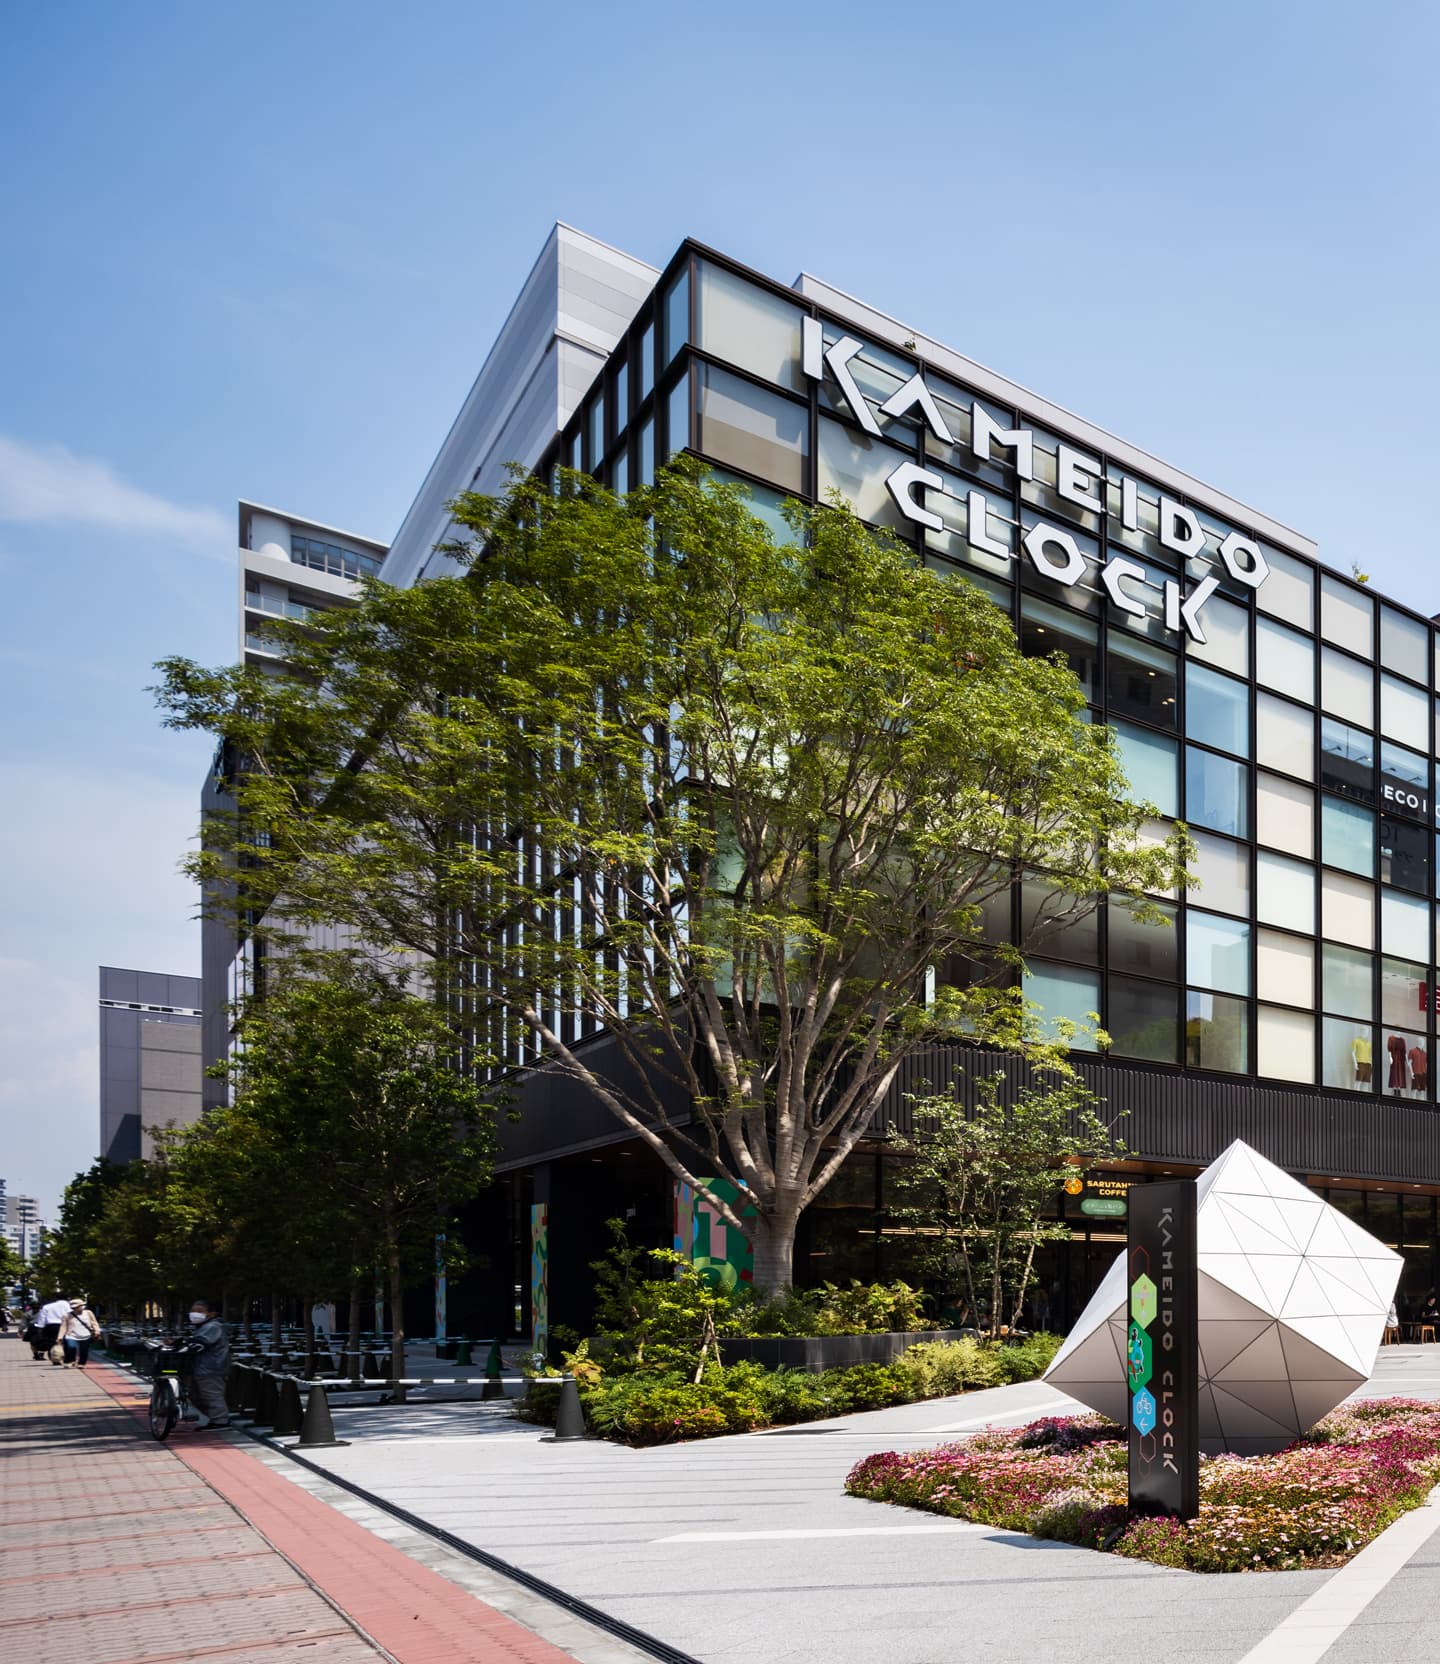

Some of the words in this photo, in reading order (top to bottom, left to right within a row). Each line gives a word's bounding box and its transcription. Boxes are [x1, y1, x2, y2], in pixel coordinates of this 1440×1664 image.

[802, 315, 1271, 589] KAMEIDO
[885, 460, 1220, 644] CLOCK
[1381, 784, 1419, 809] ECO
[1086, 1180, 1136, 1189] SARUTAH
[1099, 1188, 1127, 1197] COFFE
[1157, 1207, 1173, 1351] KAMEIDO
[1162, 1370, 1178, 1475] CLOCK
